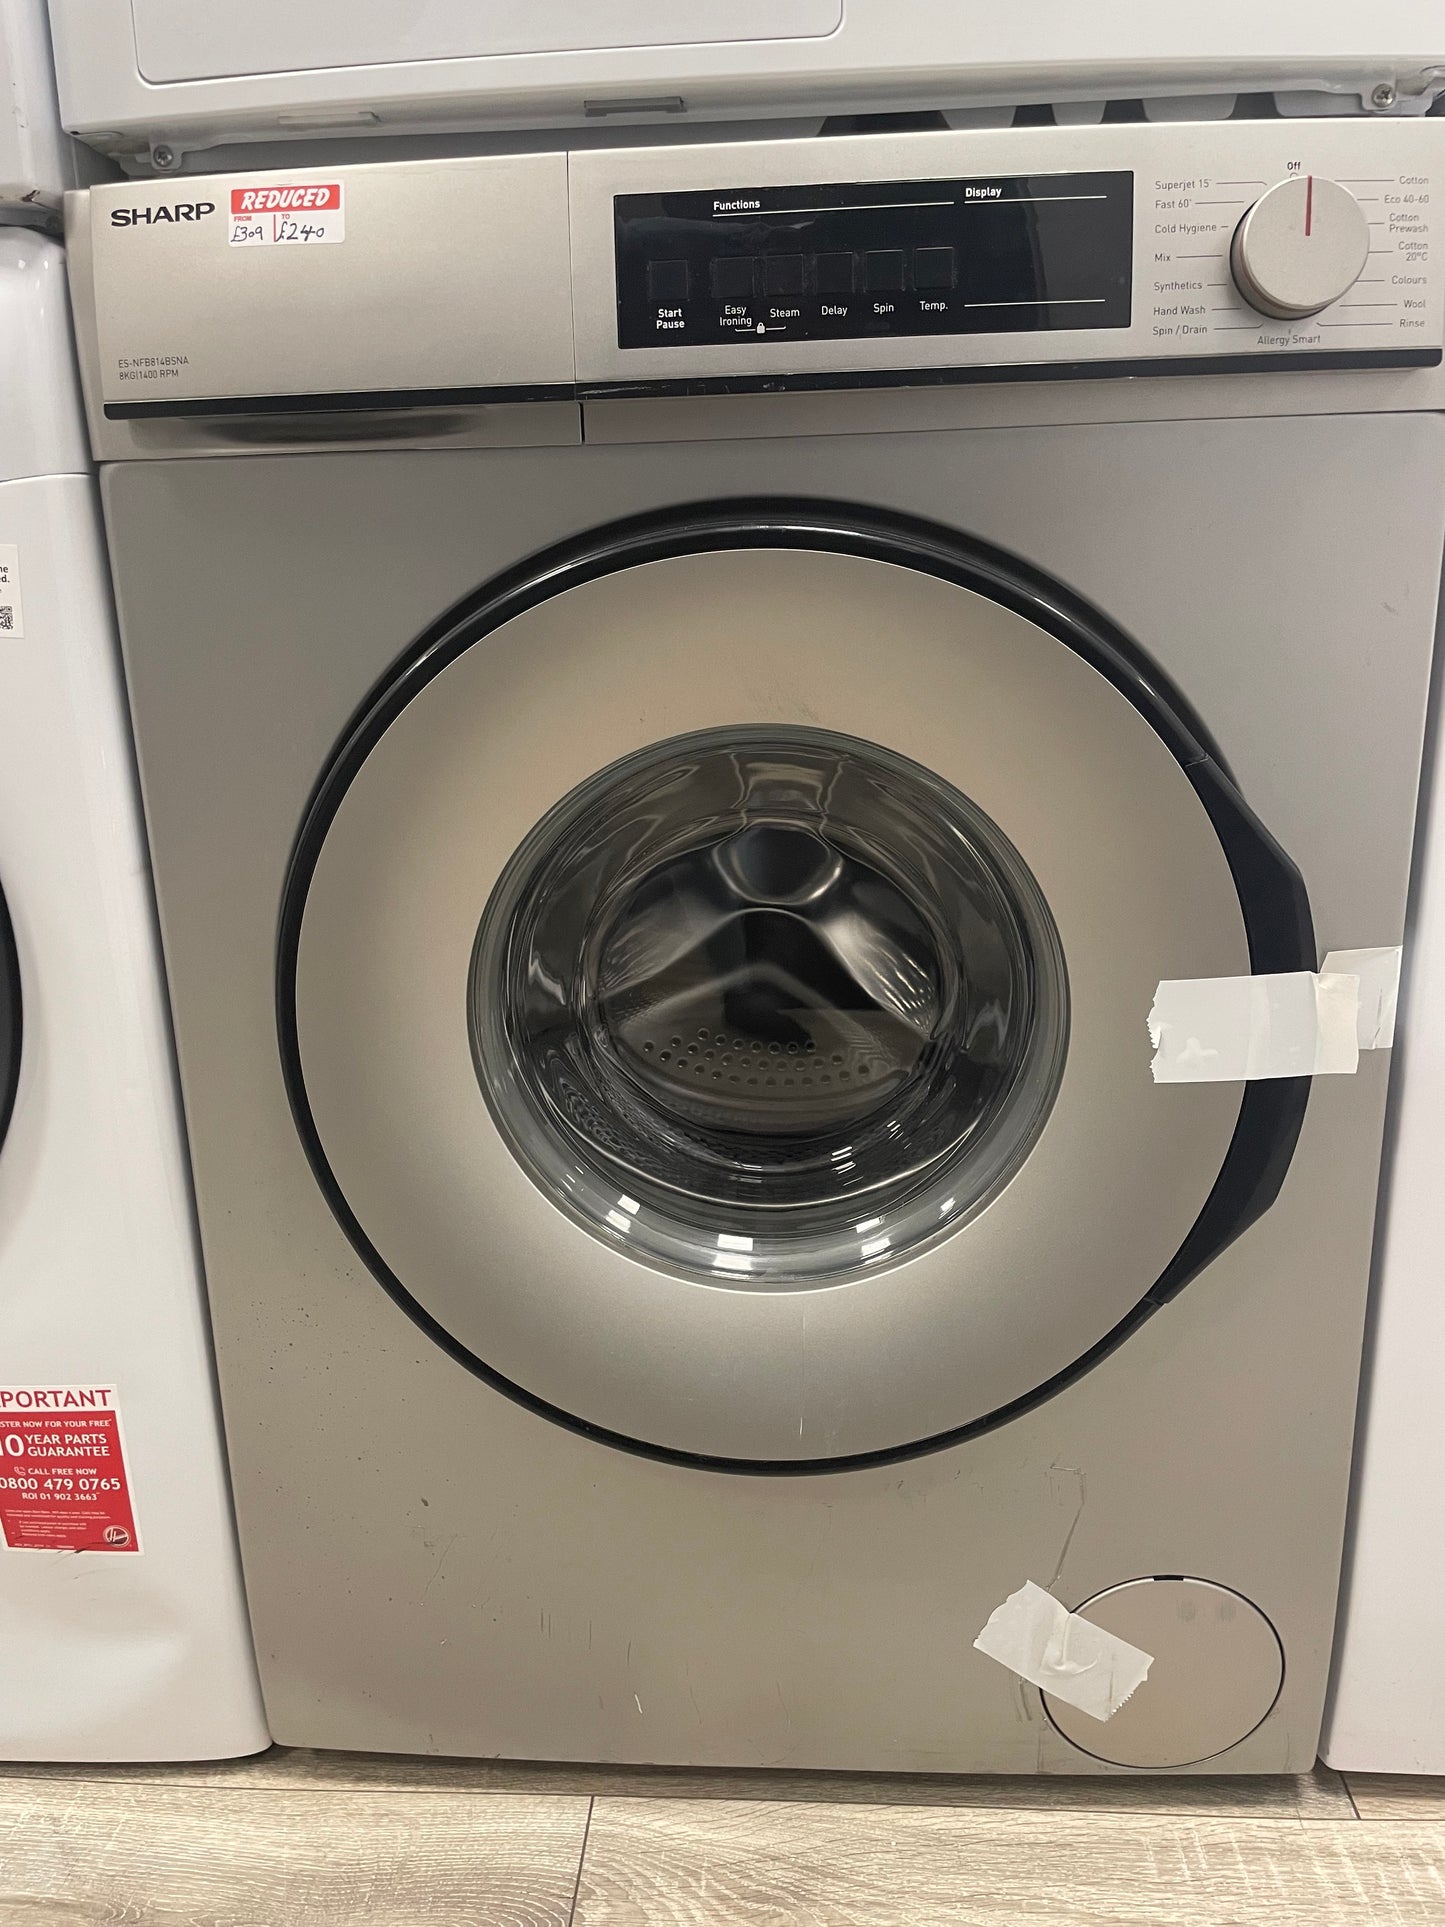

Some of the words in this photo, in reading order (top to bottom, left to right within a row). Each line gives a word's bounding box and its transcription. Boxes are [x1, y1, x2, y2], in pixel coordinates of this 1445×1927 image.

[1287, 161, 1301, 170] Off
[1155, 180, 1195, 191] Superjet
[1399, 175, 1429, 185] Cotton
[965, 186, 1002, 199] Display
[241, 188, 331, 211] REDUCED
[1155, 199, 1175, 209] Fast
[1384, 194, 1401, 204] Eco
[1403, 194, 1430, 204] 40-60
[713, 199, 760, 211] Functions
[111, 202, 215, 227] SHARP
[1389, 213, 1419, 223] Cotton
[230, 225, 263, 242] £309
[275, 221, 325, 242] £240
[1155, 223, 1176, 234] Cold
[1179, 223, 1217, 235] Hygiene
[1389, 223, 1429, 233] Prewash
[1398, 241, 1429, 251] Cotton
[1154, 253, 1171, 262] Mix
[1406, 251, 1428, 262] 20°C
[1391, 275, 1427, 285] Colours
[1154, 281, 1203, 293] Synthetics
[873, 302, 895, 315] Spin
[919, 300, 949, 312] Temp.
[1403, 299, 1426, 308] Wool
[658, 308, 682, 318] Start
[724, 305, 747, 315] Easy
[769, 308, 800, 318] Steam
[821, 305, 848, 316] Delay
[1153, 306, 1178, 316] Hand
[1180, 306, 1206, 315] Wash
[656, 319, 685, 330] Pause
[719, 316, 752, 327] Ironing
[1399, 319, 1425, 328] Rinse
[1152, 326, 1173, 337] Spin
[1182, 325, 1208, 335] Drain
[1257, 335, 1290, 347] Allergy
[1292, 334, 1321, 344] Smart
[118, 356, 190, 368] ES-NFB814BSNA
[159, 369, 179, 378] RPM
[0, 1389, 112, 1408] PORTANT
[23, 1420, 43, 1428] NOW
[45, 1420, 62, 1428] FOR
[25, 1434, 62, 1445] YEAR
[65, 1433, 107, 1445] PARTS
[27, 1446, 110, 1457] GUARANTEE
[0, 1477, 38, 1490] 0800
[44, 1478, 74, 1490] 479
[79, 1478, 121, 1490] 0765
[54, 1493, 72, 1501] 902
